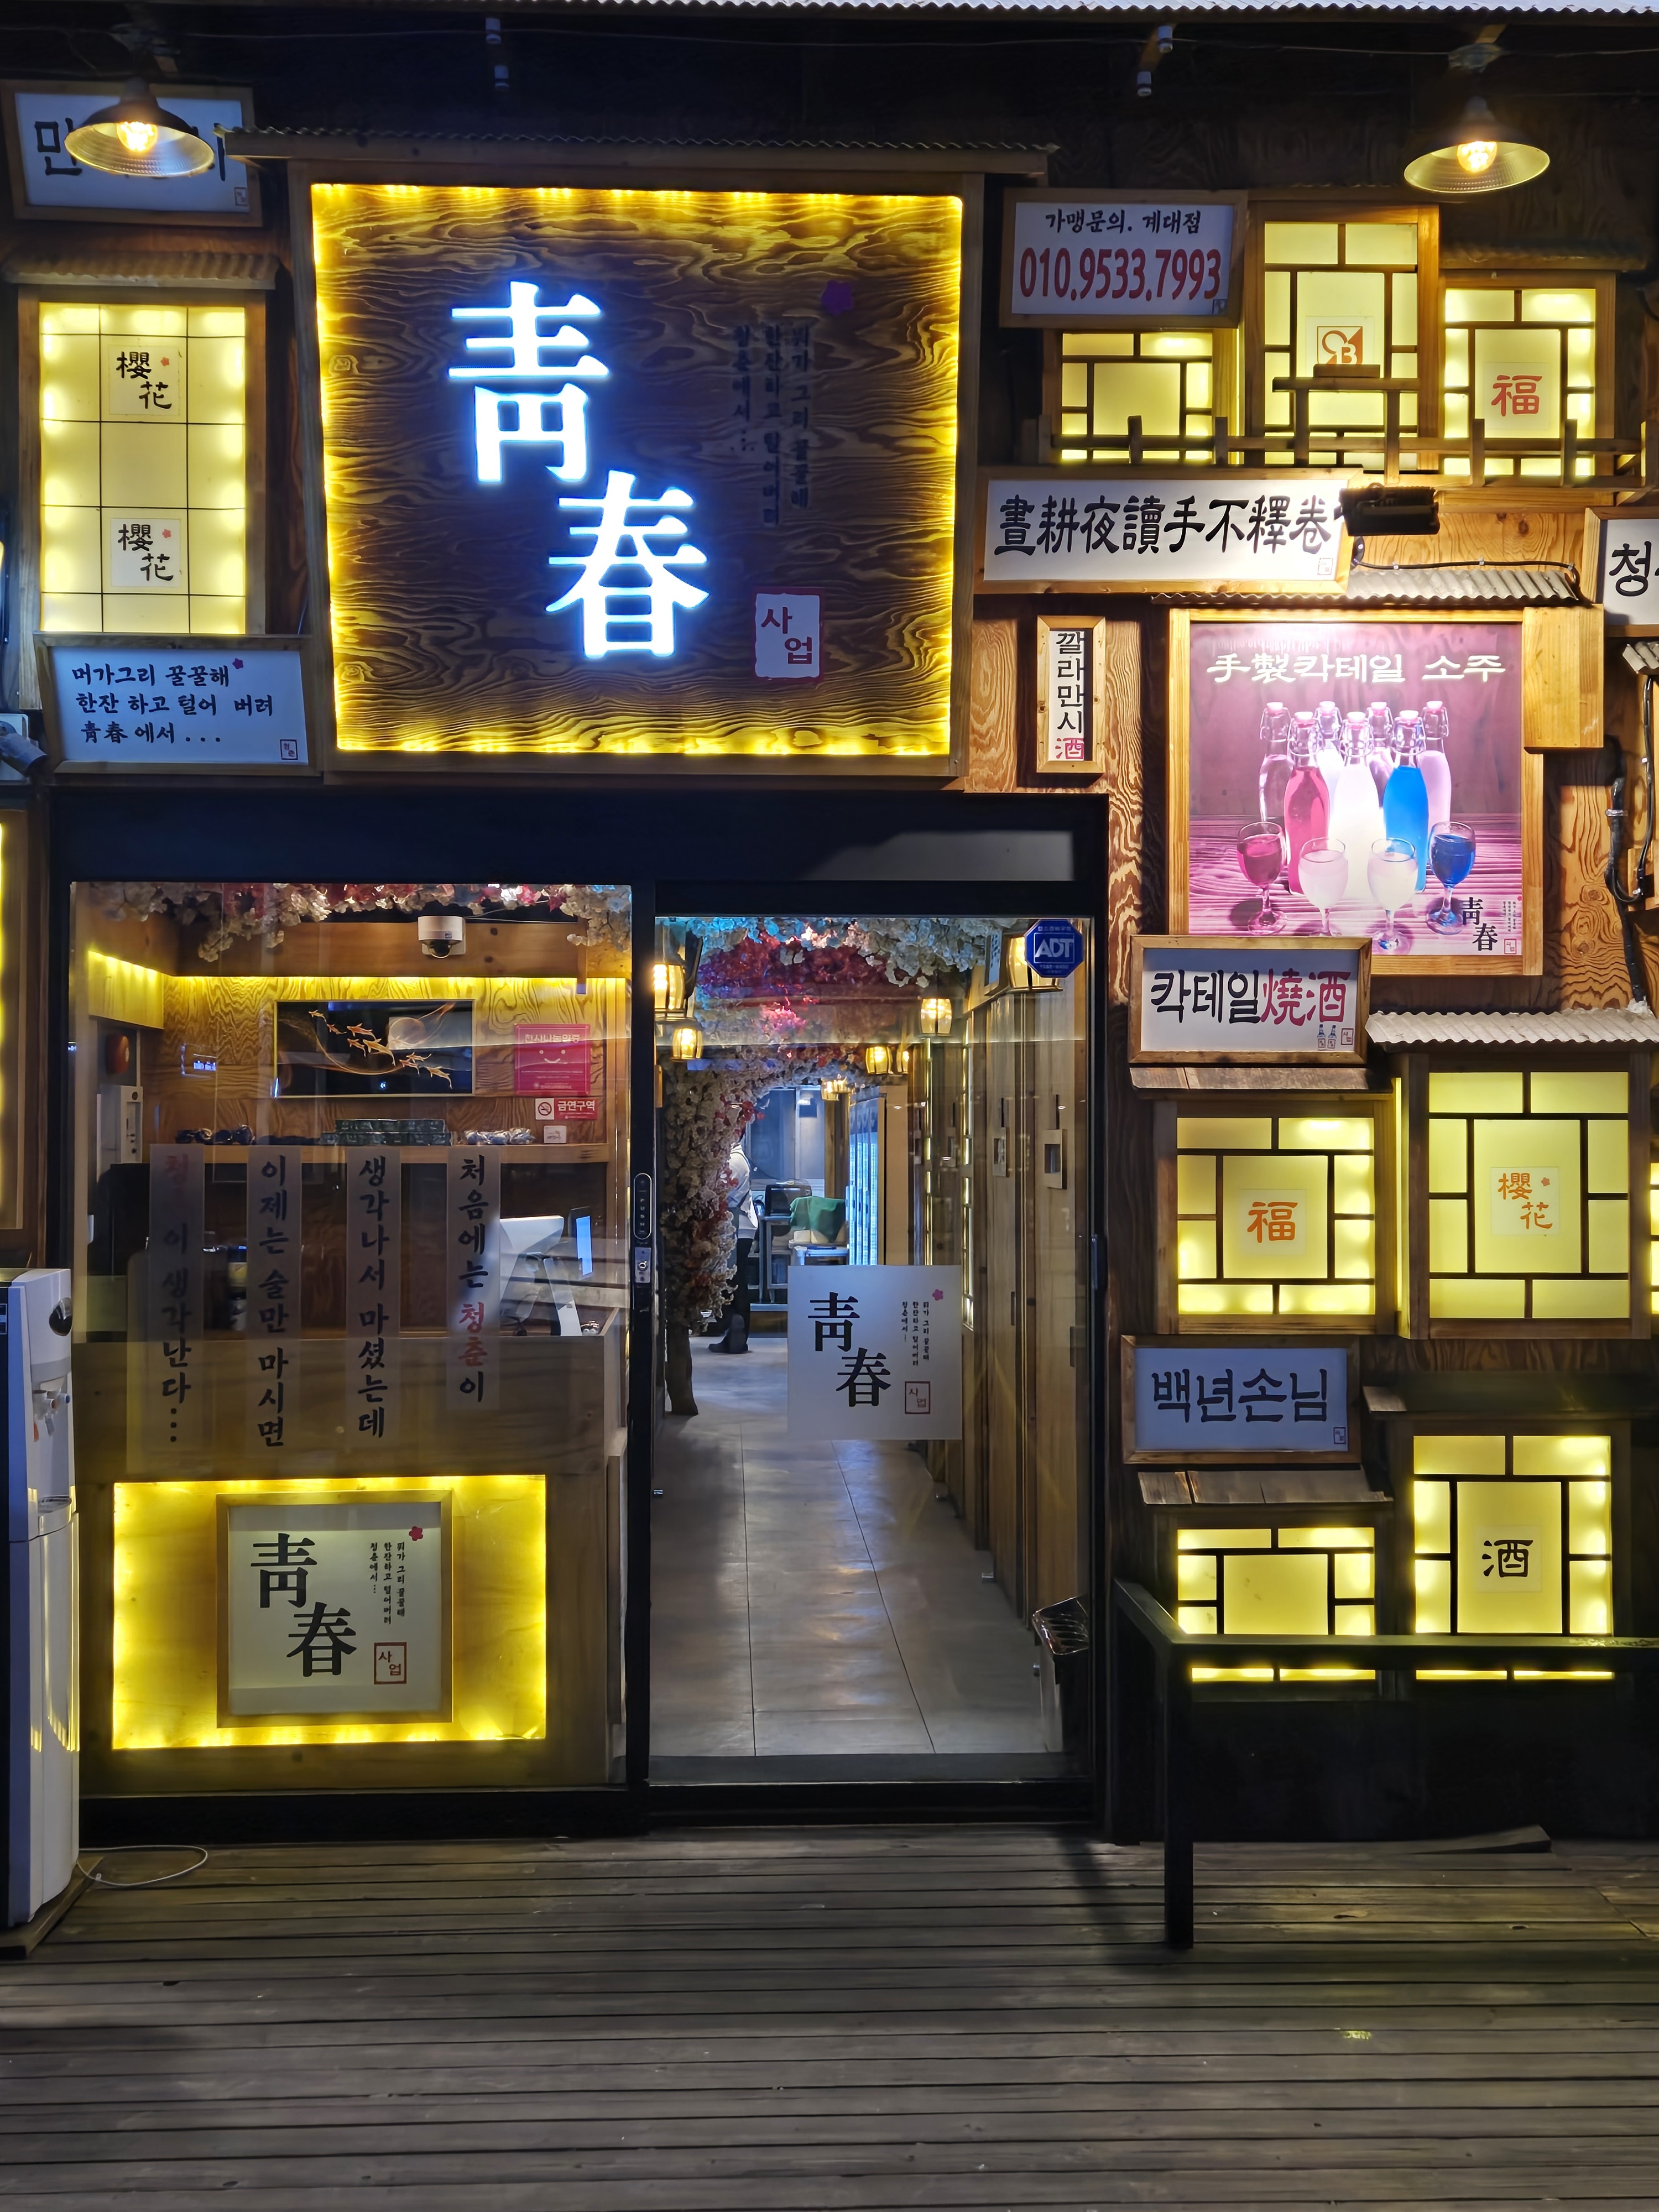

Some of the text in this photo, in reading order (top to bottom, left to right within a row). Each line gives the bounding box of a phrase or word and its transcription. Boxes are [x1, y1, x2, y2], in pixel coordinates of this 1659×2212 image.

[1046, 208, 1132, 234] 가맹문의.
[1020, 247, 1222, 301] 010.9533.7993
[1491, 374, 1542, 416] 福
[1609, 541, 1659, 597] 청
[761, 606, 813, 665] 사업
[165, 665, 229, 687] 꿀꿀해
[1207, 653, 1506, 684] 手製칵테일 소주
[75, 692, 273, 716] 한잔 하고 털어 버려
[1056, 632, 1084, 760] 깔라만시酒
[1035, 938, 1074, 958] ADT
[1151, 968, 1351, 1026] 칵테일燒酒
[557, 1100, 595, 1112] 금연구역
[1248, 1202, 1298, 1243] 福
[358, 1155, 389, 1439] 생각나서 마셨는데
[459, 1155, 489, 1402] 처음에는 청춘이
[258, 1155, 289, 1447] 이제는 술만 마시면
[1152, 1368, 1327, 1423] 백년손님
[1481, 1540, 1533, 1578] 酒
[378, 1651, 402, 1676] 사업
